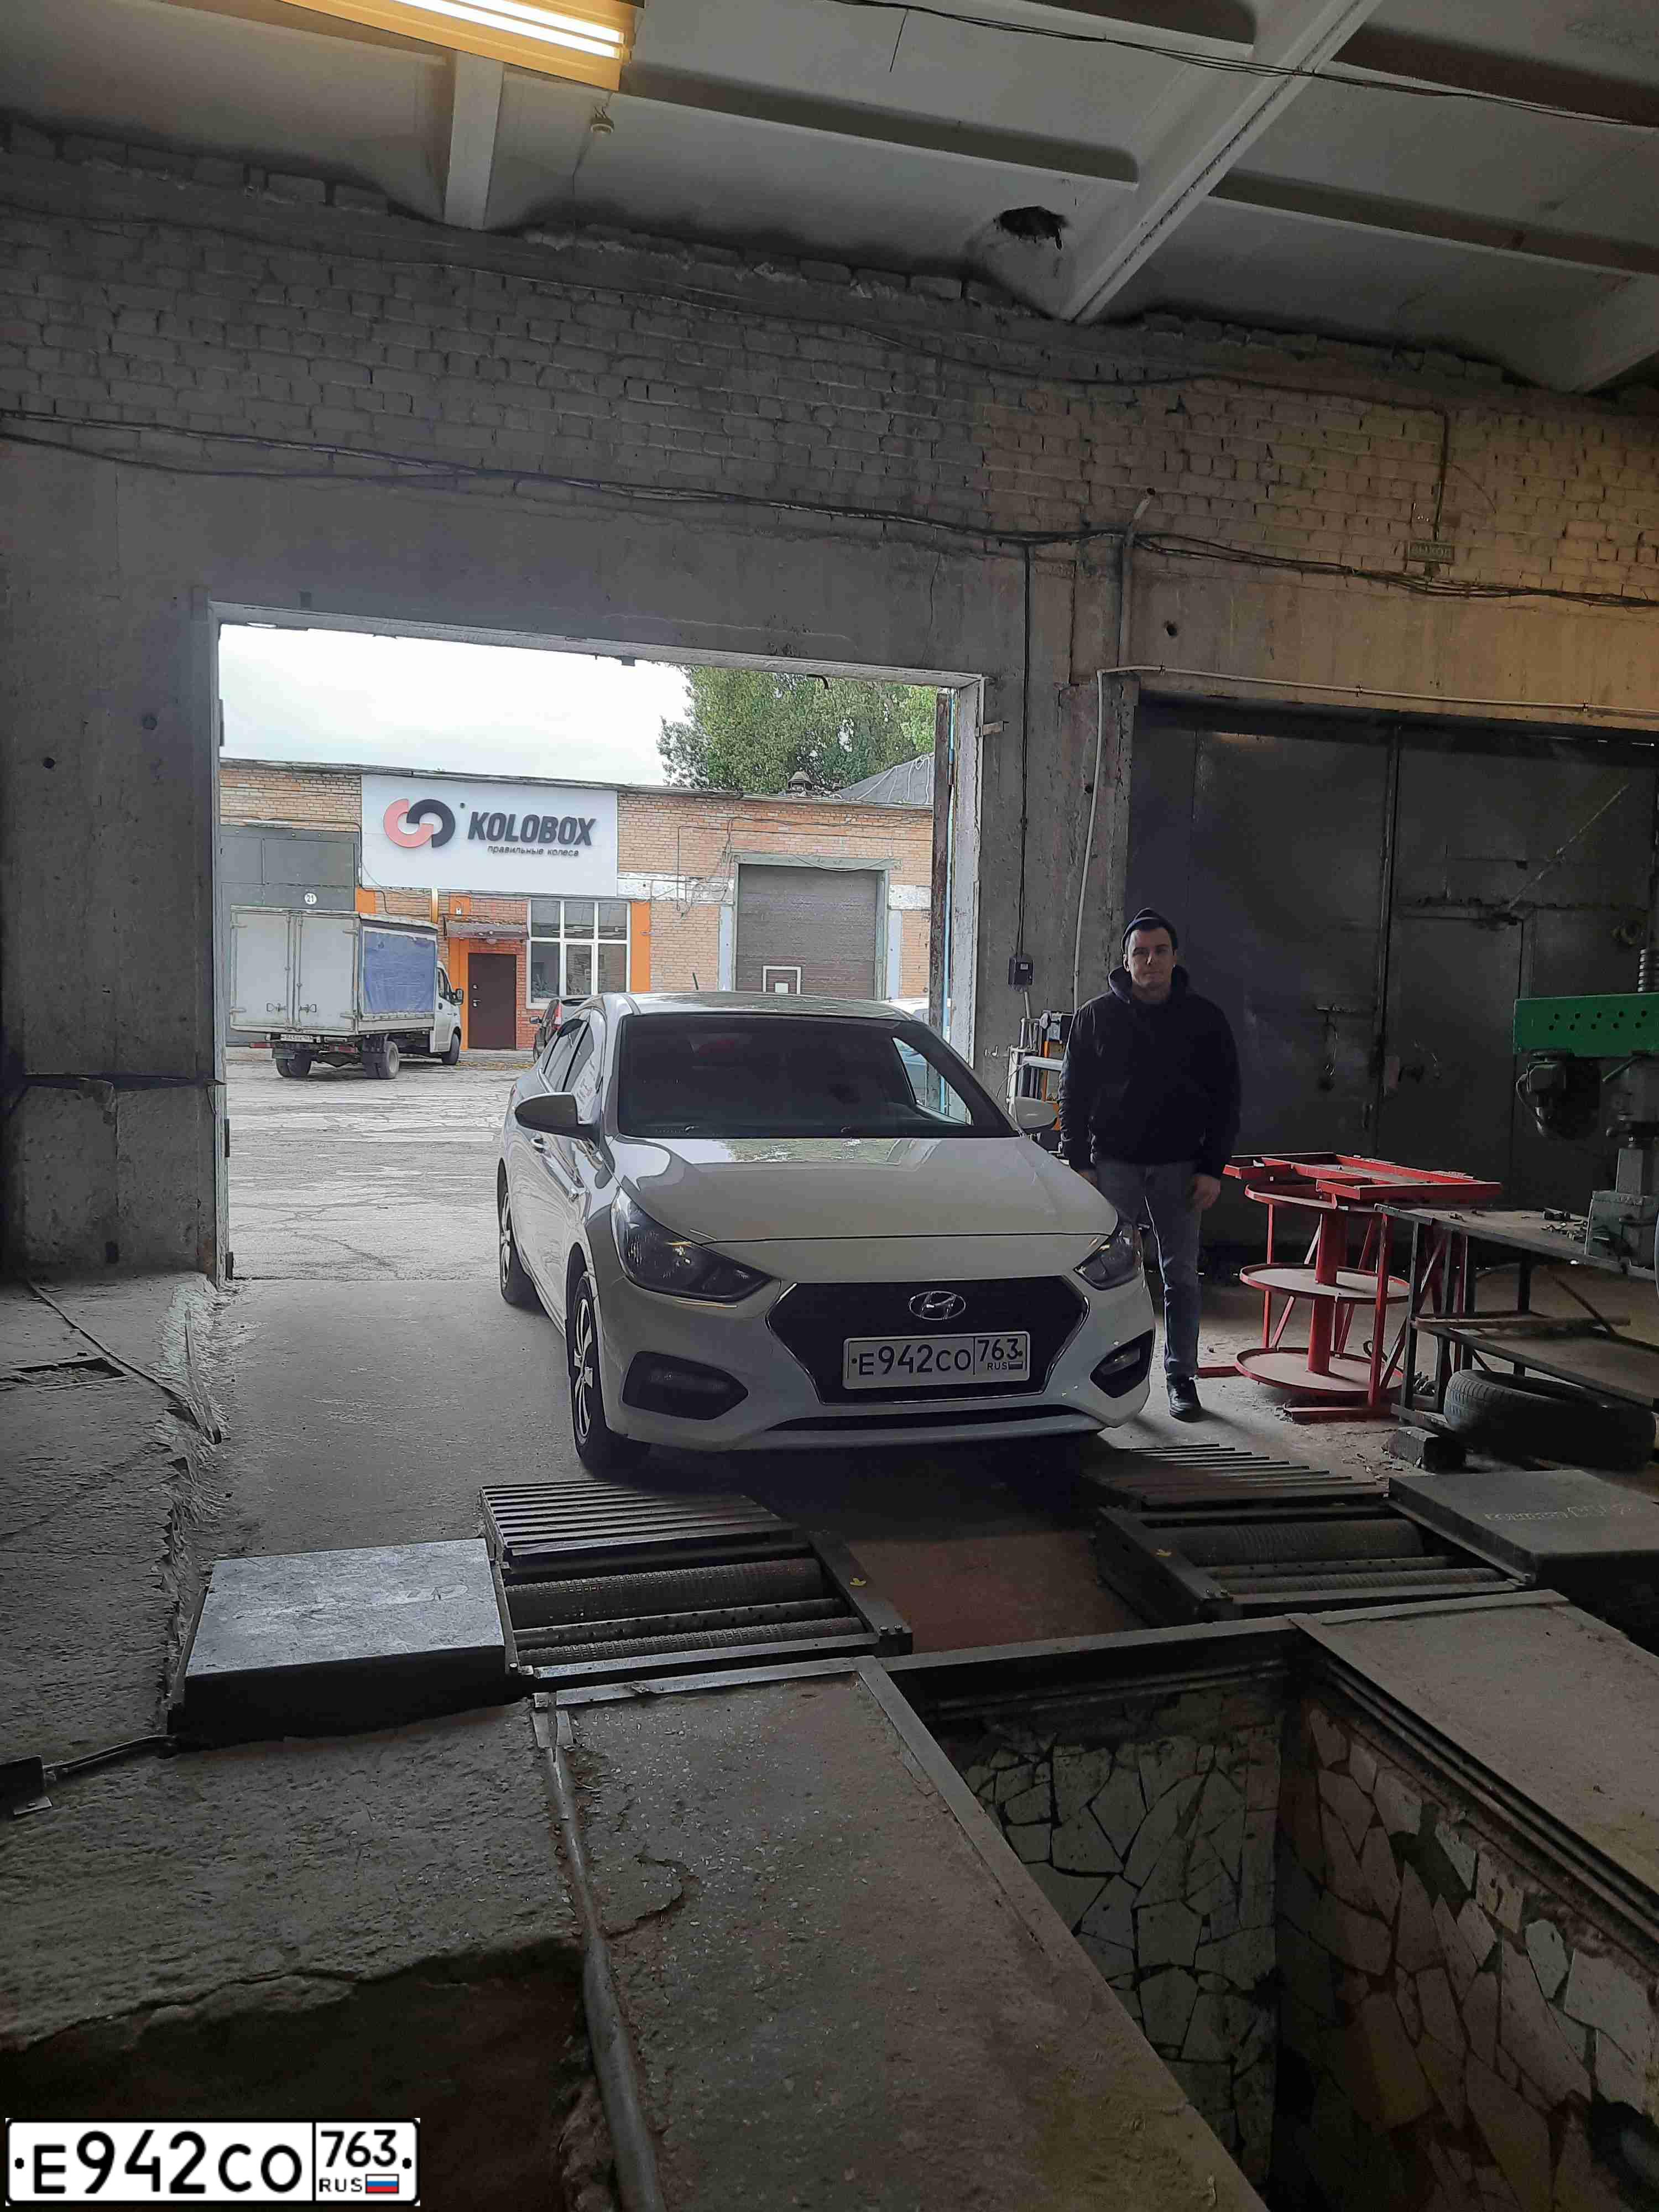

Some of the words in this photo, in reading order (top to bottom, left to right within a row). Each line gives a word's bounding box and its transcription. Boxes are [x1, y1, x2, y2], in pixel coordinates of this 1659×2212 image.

[468, 811, 597, 846] KOLOBOX
[487, 844, 544, 855] правильные
[547, 849, 579, 857] колеса
[859, 1344, 972, 1376] E942CO
[978, 1338, 1020, 1362] 763
[987, 1362, 1008, 1371] RUS
